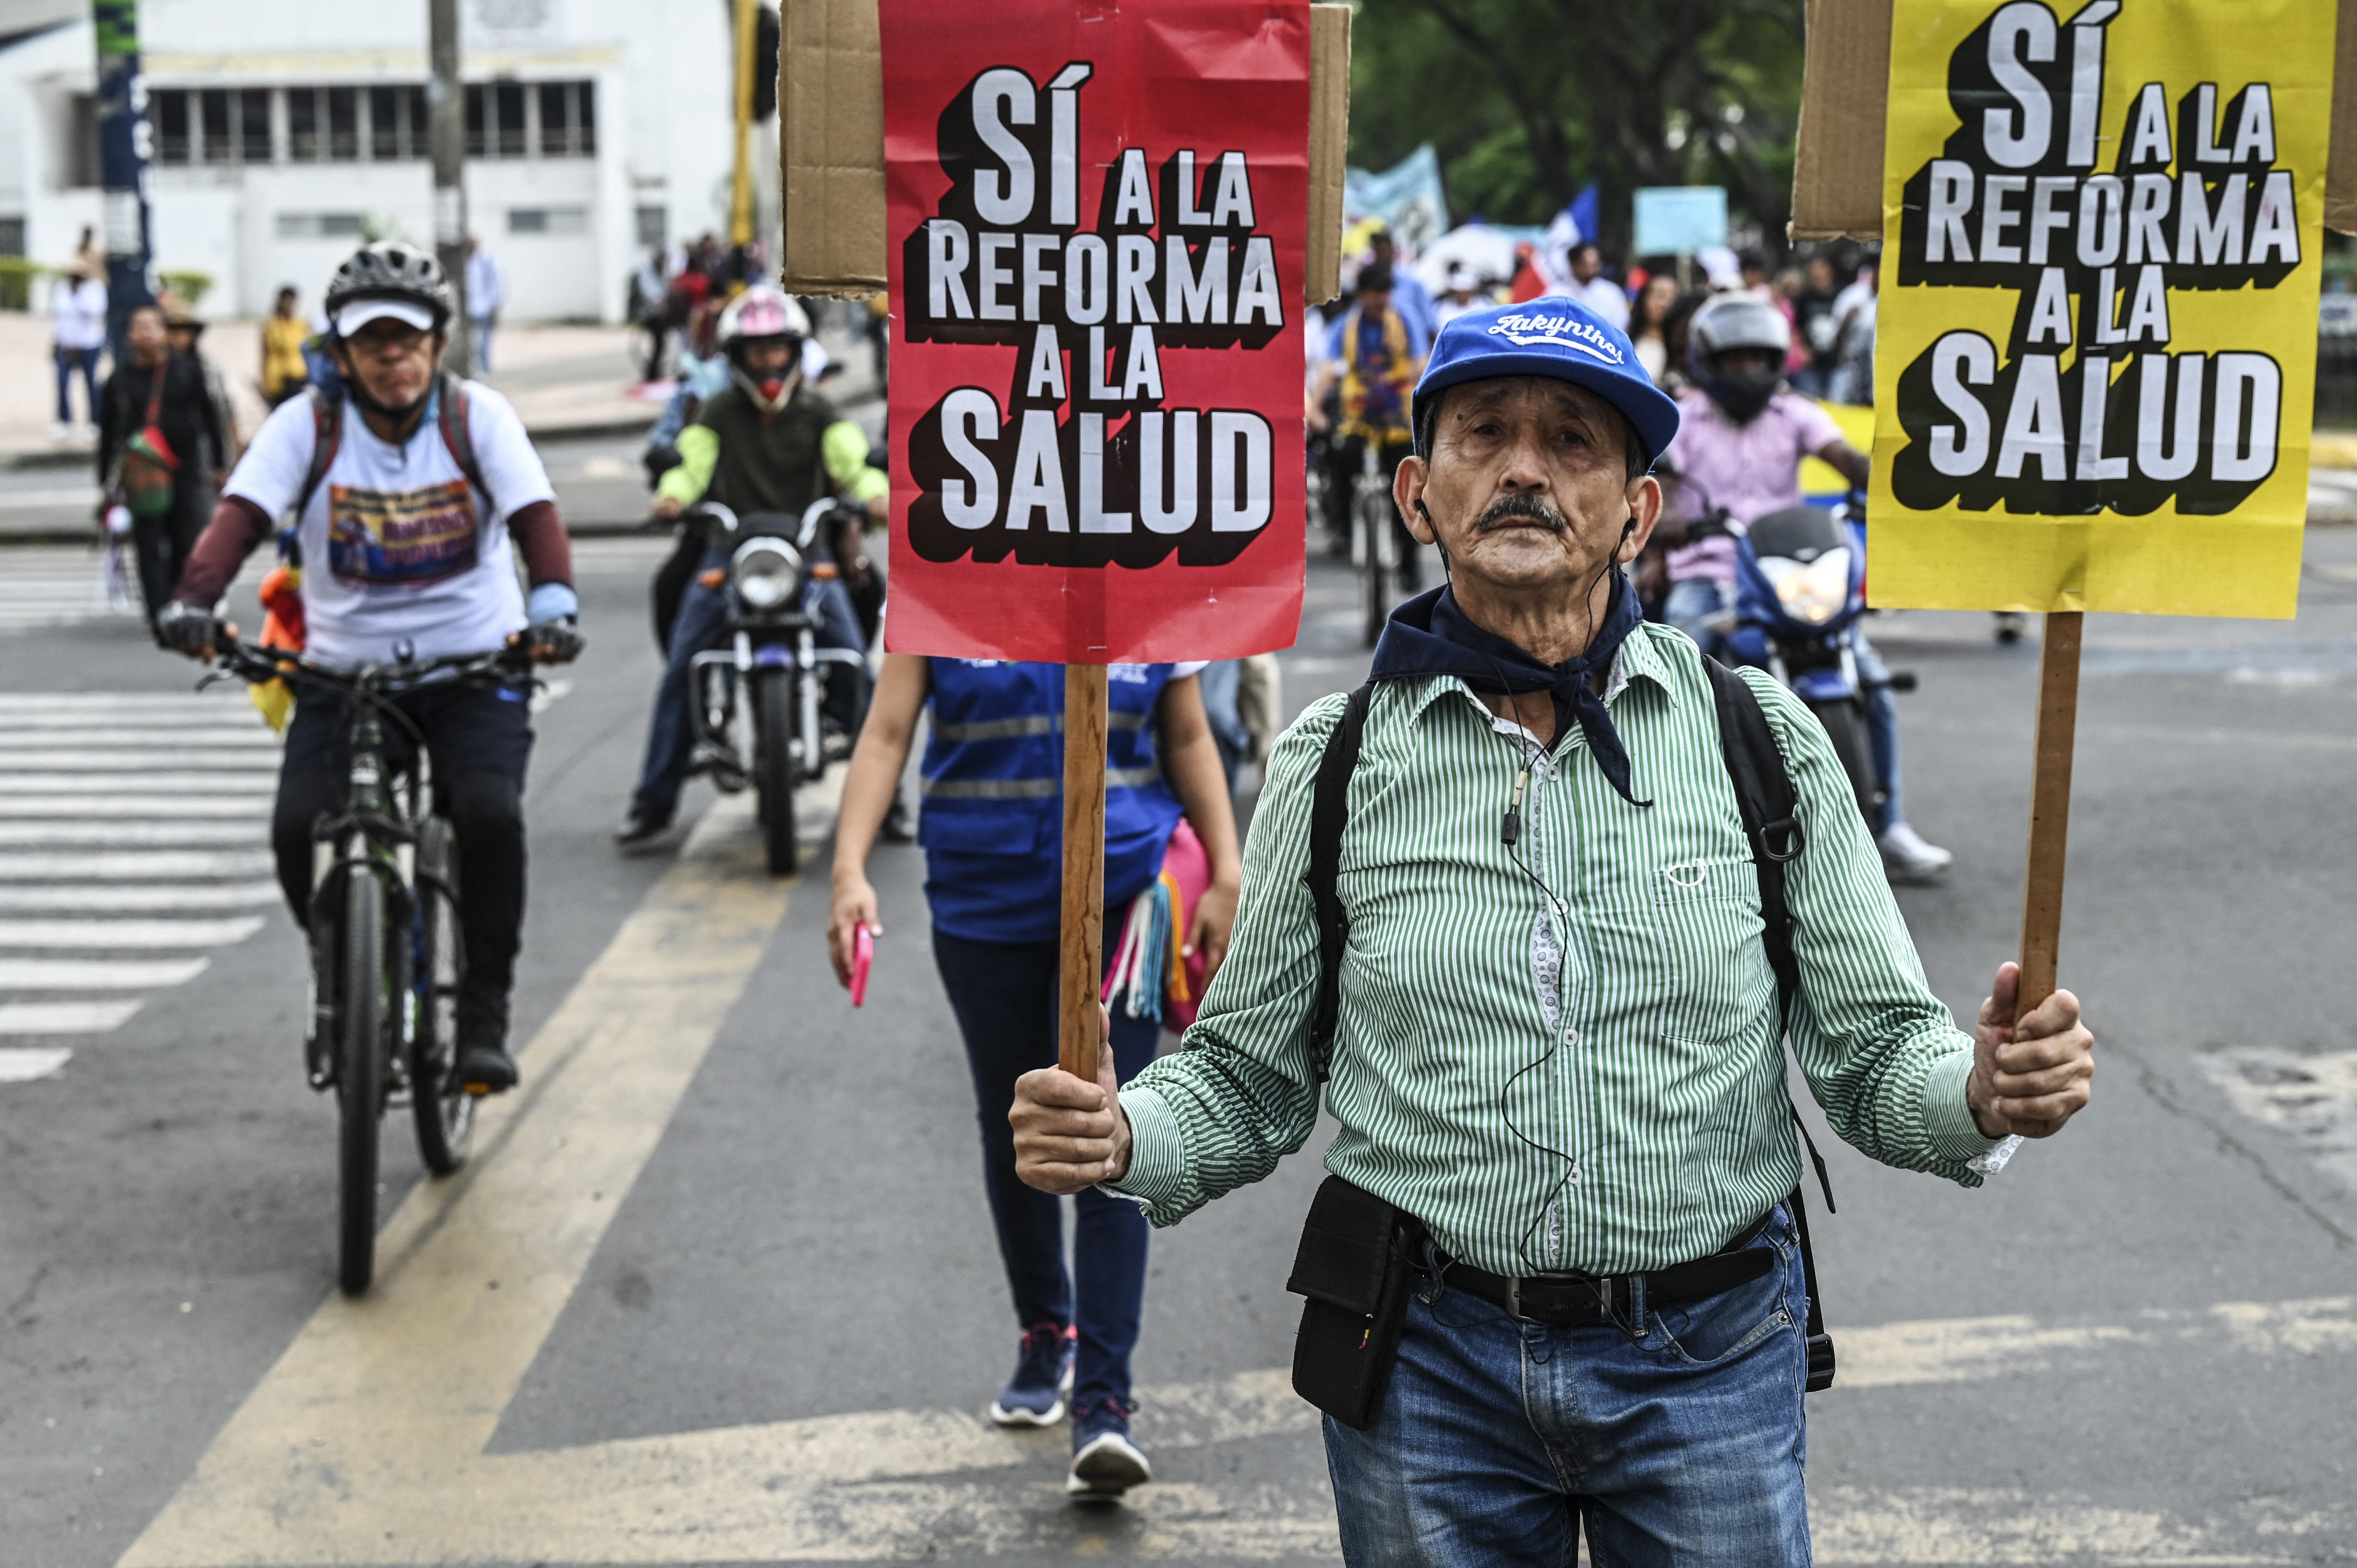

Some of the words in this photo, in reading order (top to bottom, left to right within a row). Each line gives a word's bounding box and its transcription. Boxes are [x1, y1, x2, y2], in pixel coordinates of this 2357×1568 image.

[1984, 0, 2118, 168] SÍ
[2131, 85, 2171, 163] A
[2197, 85, 2274, 163] LA
[973, 65, 1089, 225] SÍ
[1115, 149, 1154, 225] A
[1179, 151, 1254, 227] LA
[1926, 161, 2299, 267] REFORMA
[929, 220, 1282, 325] REFORMA
[2027, 267, 2071, 343] A
[2096, 265, 2169, 344] LA
[1027, 325, 1066, 398] A
[1090, 325, 1163, 400] LA
[1488, 313, 1624, 365] Zakynthos
[1930, 333, 2279, 481] SALUD
[941, 389, 1271, 534] SALUD
